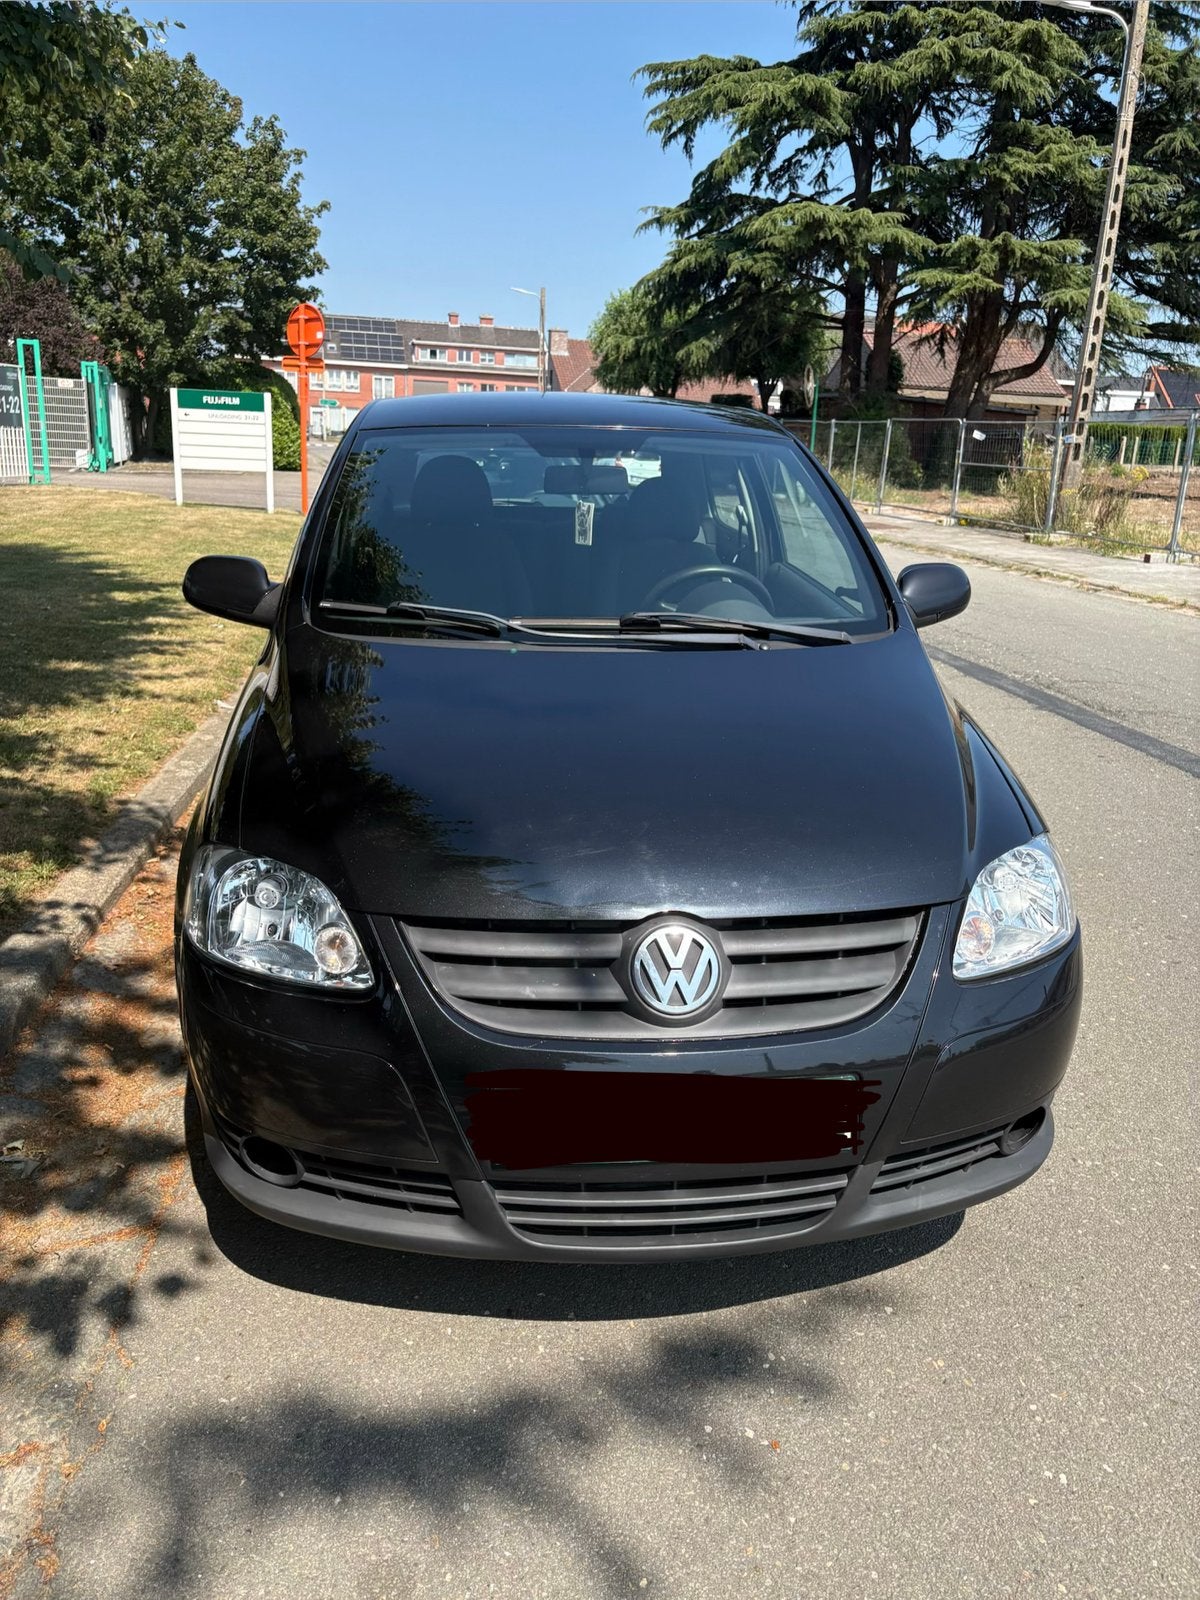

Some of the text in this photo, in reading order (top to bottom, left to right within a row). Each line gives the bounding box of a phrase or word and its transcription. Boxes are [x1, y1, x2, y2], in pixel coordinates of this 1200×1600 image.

[0, 396, 20, 413] 1-22
[203, 395, 240, 405] FUJIFILM
[634, 926, 719, 1014] VW
